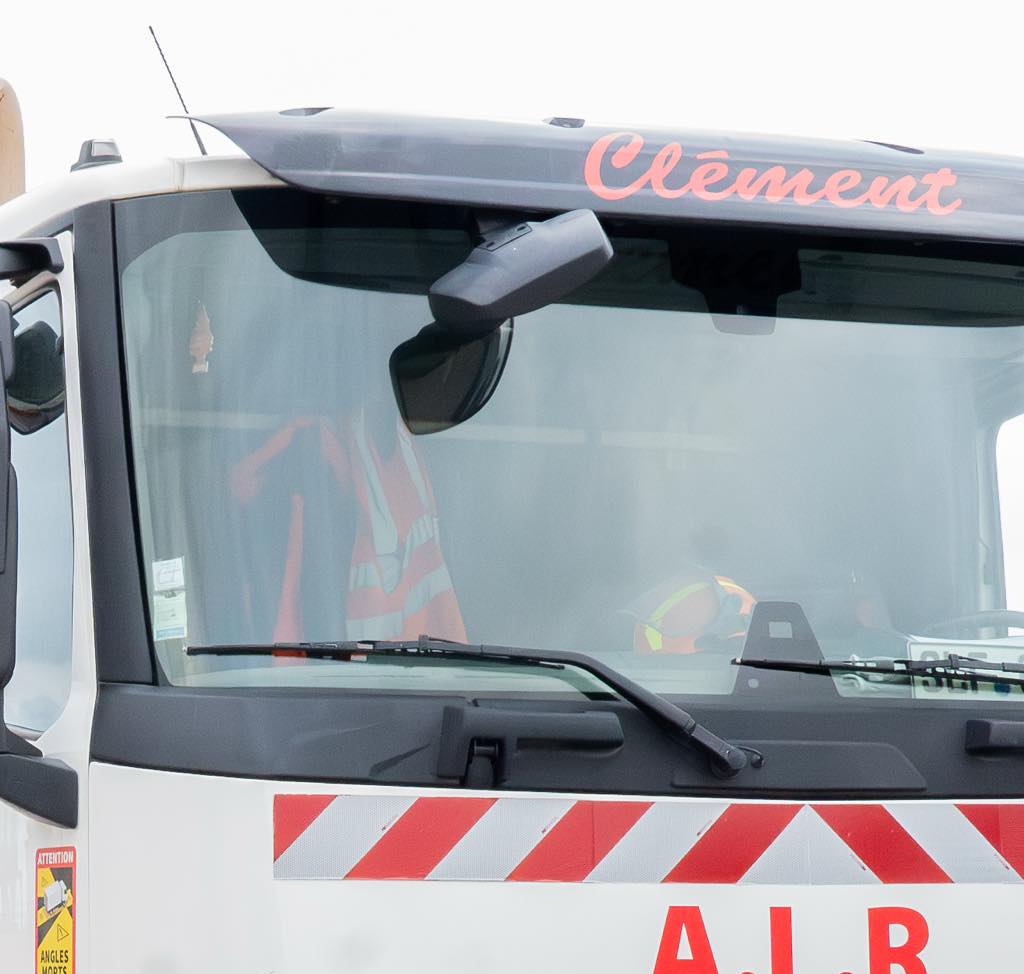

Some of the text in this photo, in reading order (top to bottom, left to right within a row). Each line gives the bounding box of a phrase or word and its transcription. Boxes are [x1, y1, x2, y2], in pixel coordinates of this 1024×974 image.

[584, 132, 962, 216] Clément
[37, 851, 74, 865] ATTENTION
[40, 950, 69, 963] ANGLES
